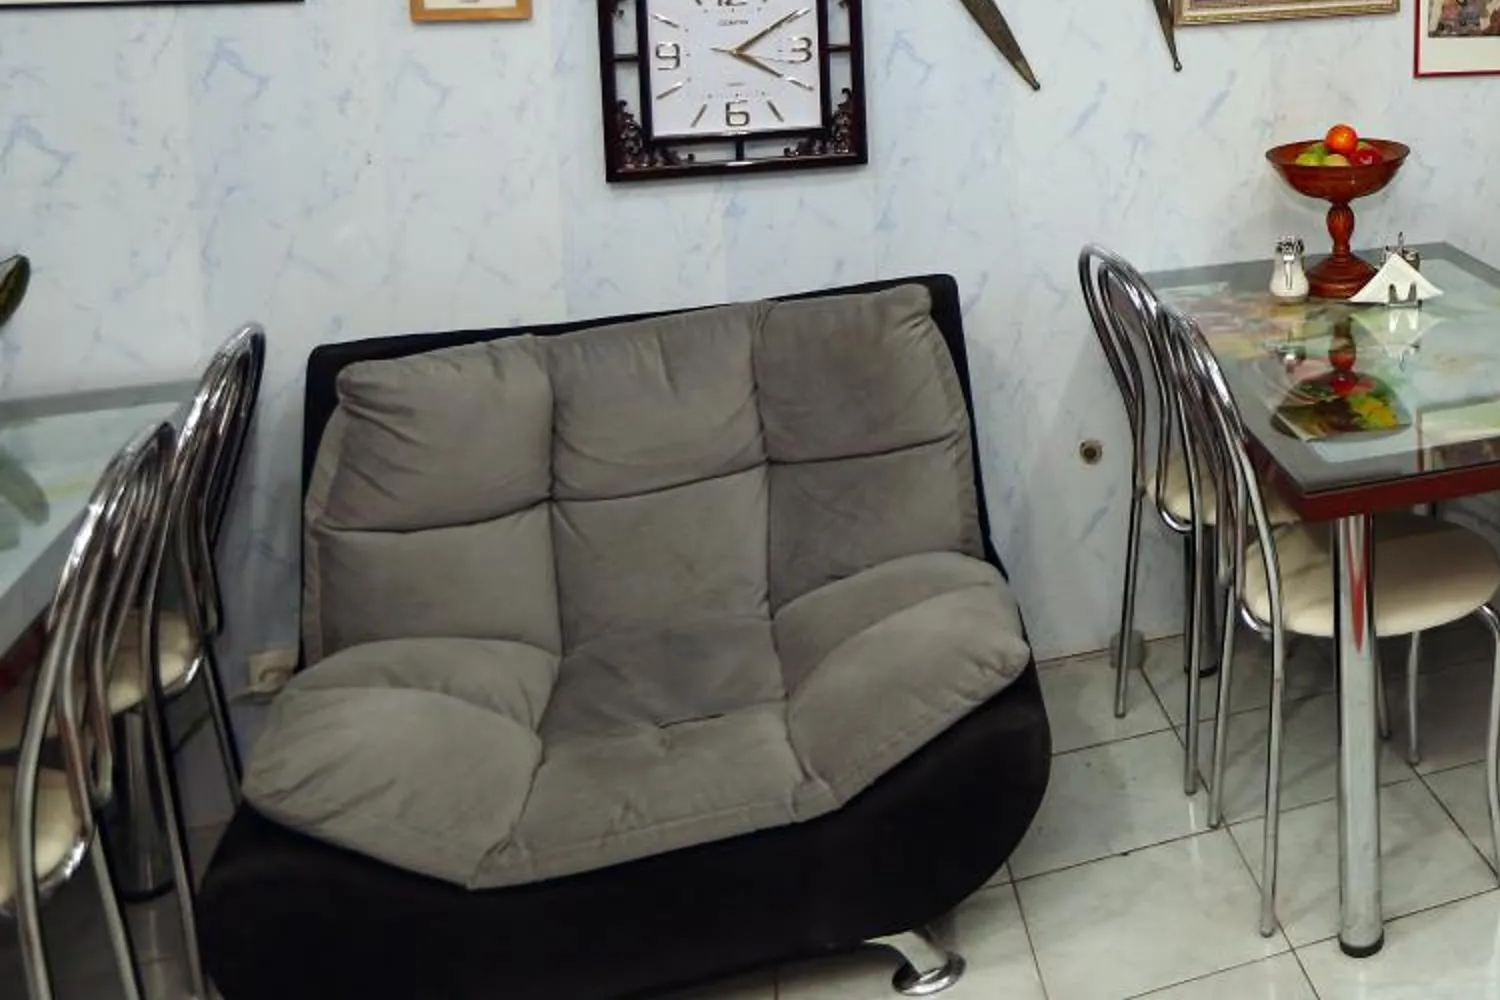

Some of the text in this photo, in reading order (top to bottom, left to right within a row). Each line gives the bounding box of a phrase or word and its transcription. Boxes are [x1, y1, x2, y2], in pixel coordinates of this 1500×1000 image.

[655, 43, 681, 71] 9
[790, 37, 813, 63] 3
[724, 100, 750, 128] 6
